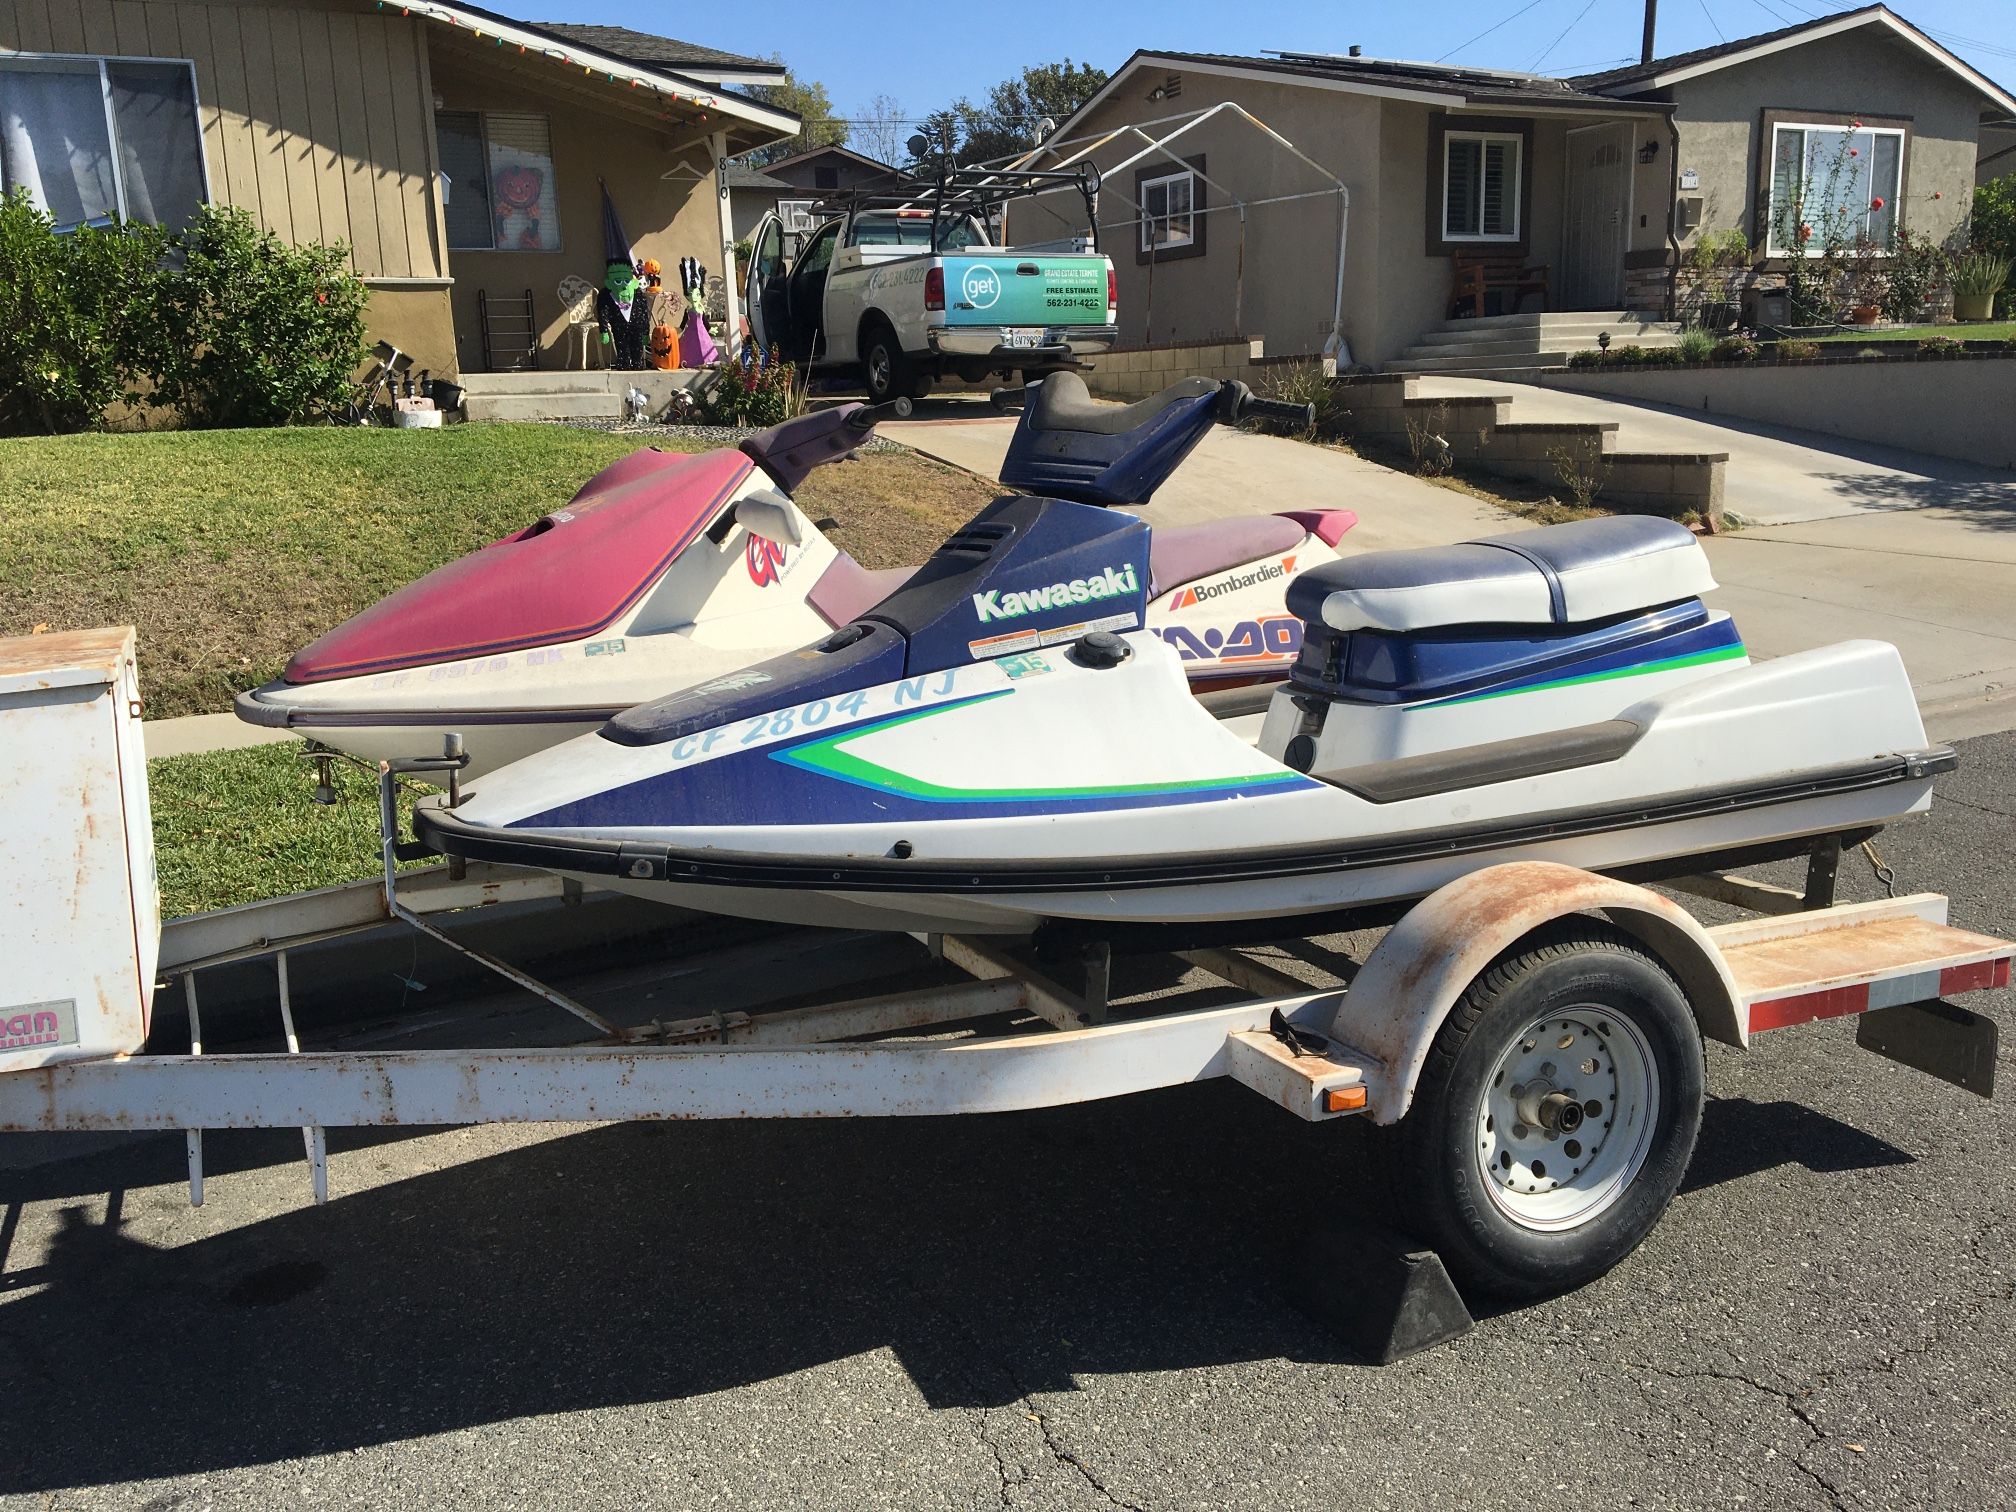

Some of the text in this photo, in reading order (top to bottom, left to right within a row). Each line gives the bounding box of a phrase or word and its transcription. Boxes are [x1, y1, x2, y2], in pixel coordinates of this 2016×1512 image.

[719, 157, 729, 200] 810
[968, 277, 995, 299] get
[1061, 269, 1079, 278] ESTATE
[1079, 269, 1099, 278] TERMITE
[1046, 299, 1099, 307] 562-231-4222
[973, 563, 1140, 623] Kawasaki
[1193, 564, 1284, 602] Bombardier
[1014, 654, 1049, 671] 15
[671, 667, 962, 761] CF 2804 NJ
